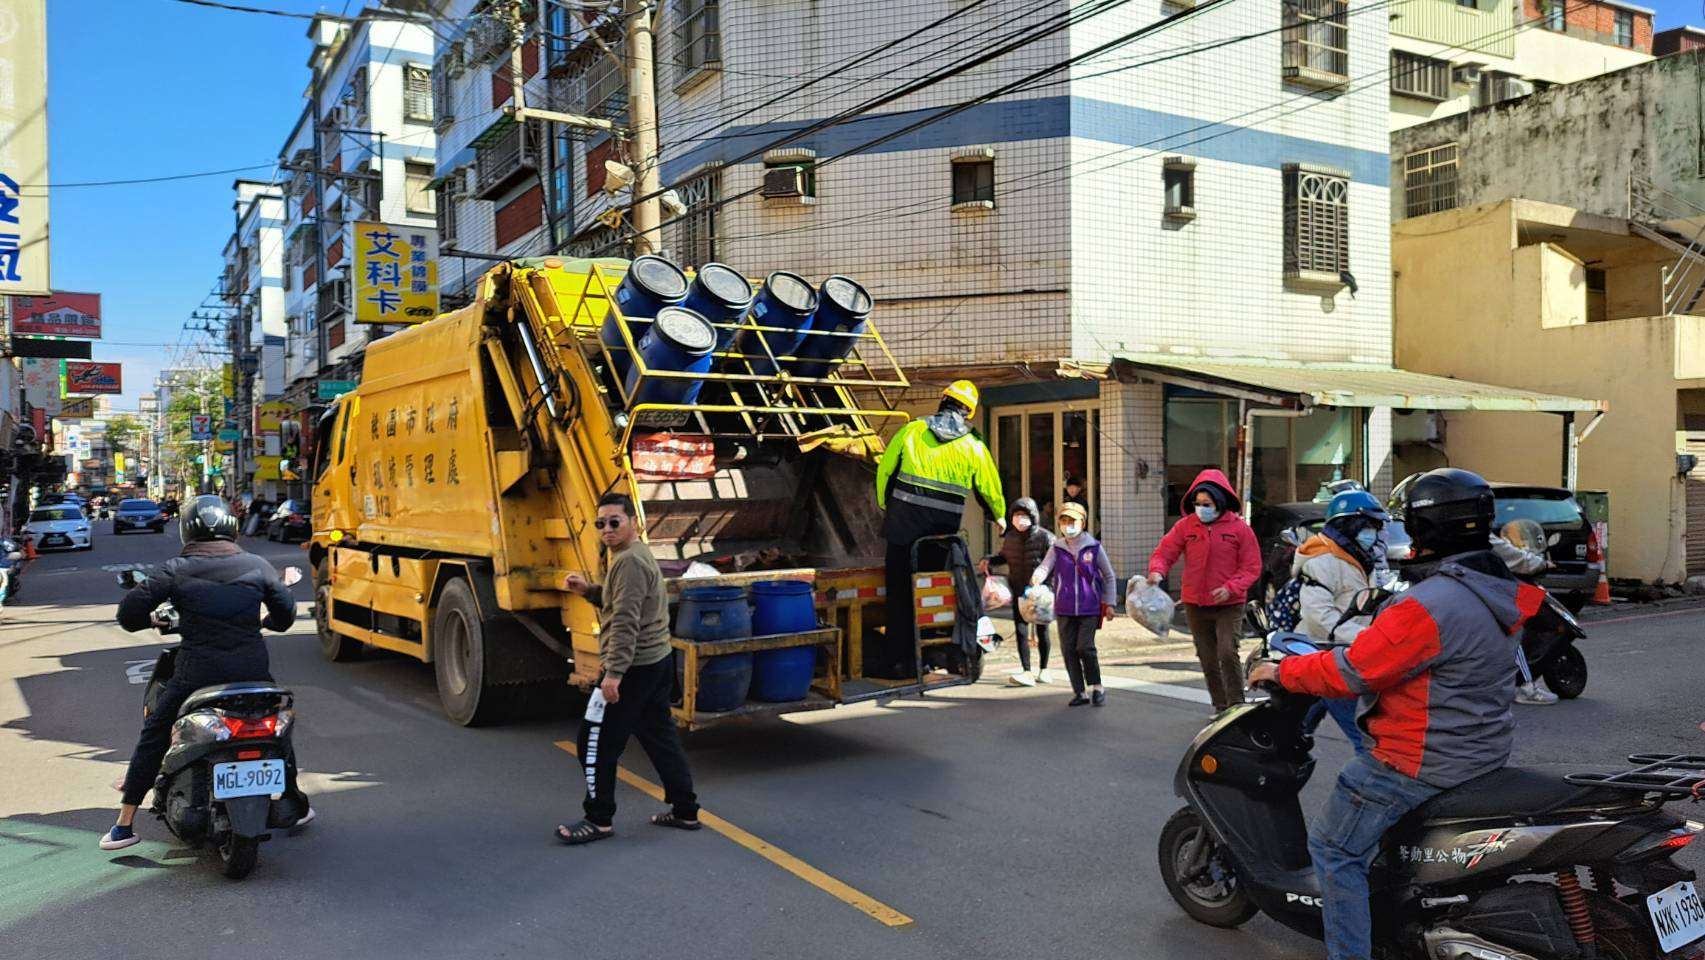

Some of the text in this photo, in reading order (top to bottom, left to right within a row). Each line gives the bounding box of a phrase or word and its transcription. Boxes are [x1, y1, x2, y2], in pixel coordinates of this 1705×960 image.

[365, 231, 402, 314] 艾科卡
[217, 768, 282, 790] MGL-9092
